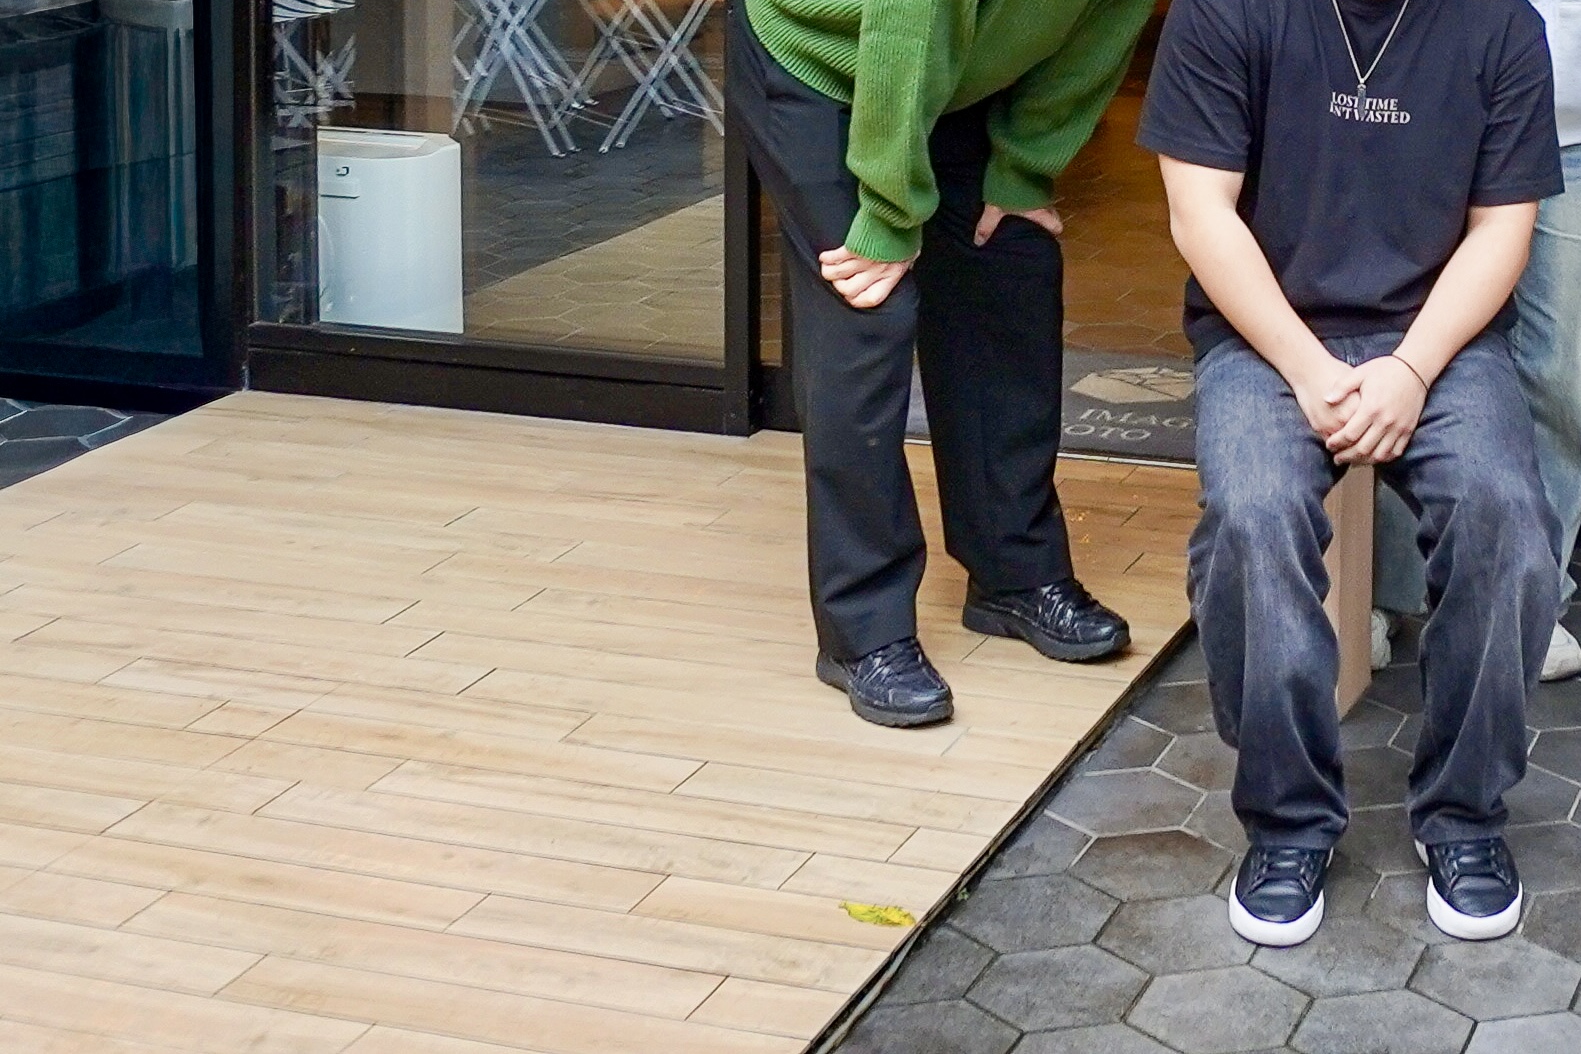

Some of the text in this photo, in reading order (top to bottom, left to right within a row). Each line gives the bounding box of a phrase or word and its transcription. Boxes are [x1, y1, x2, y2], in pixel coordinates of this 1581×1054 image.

[1330, 91, 1399, 110] LOST TIME
[1353, 109, 1411, 124] WASTED
[1062, 423, 1152, 441] OTO
